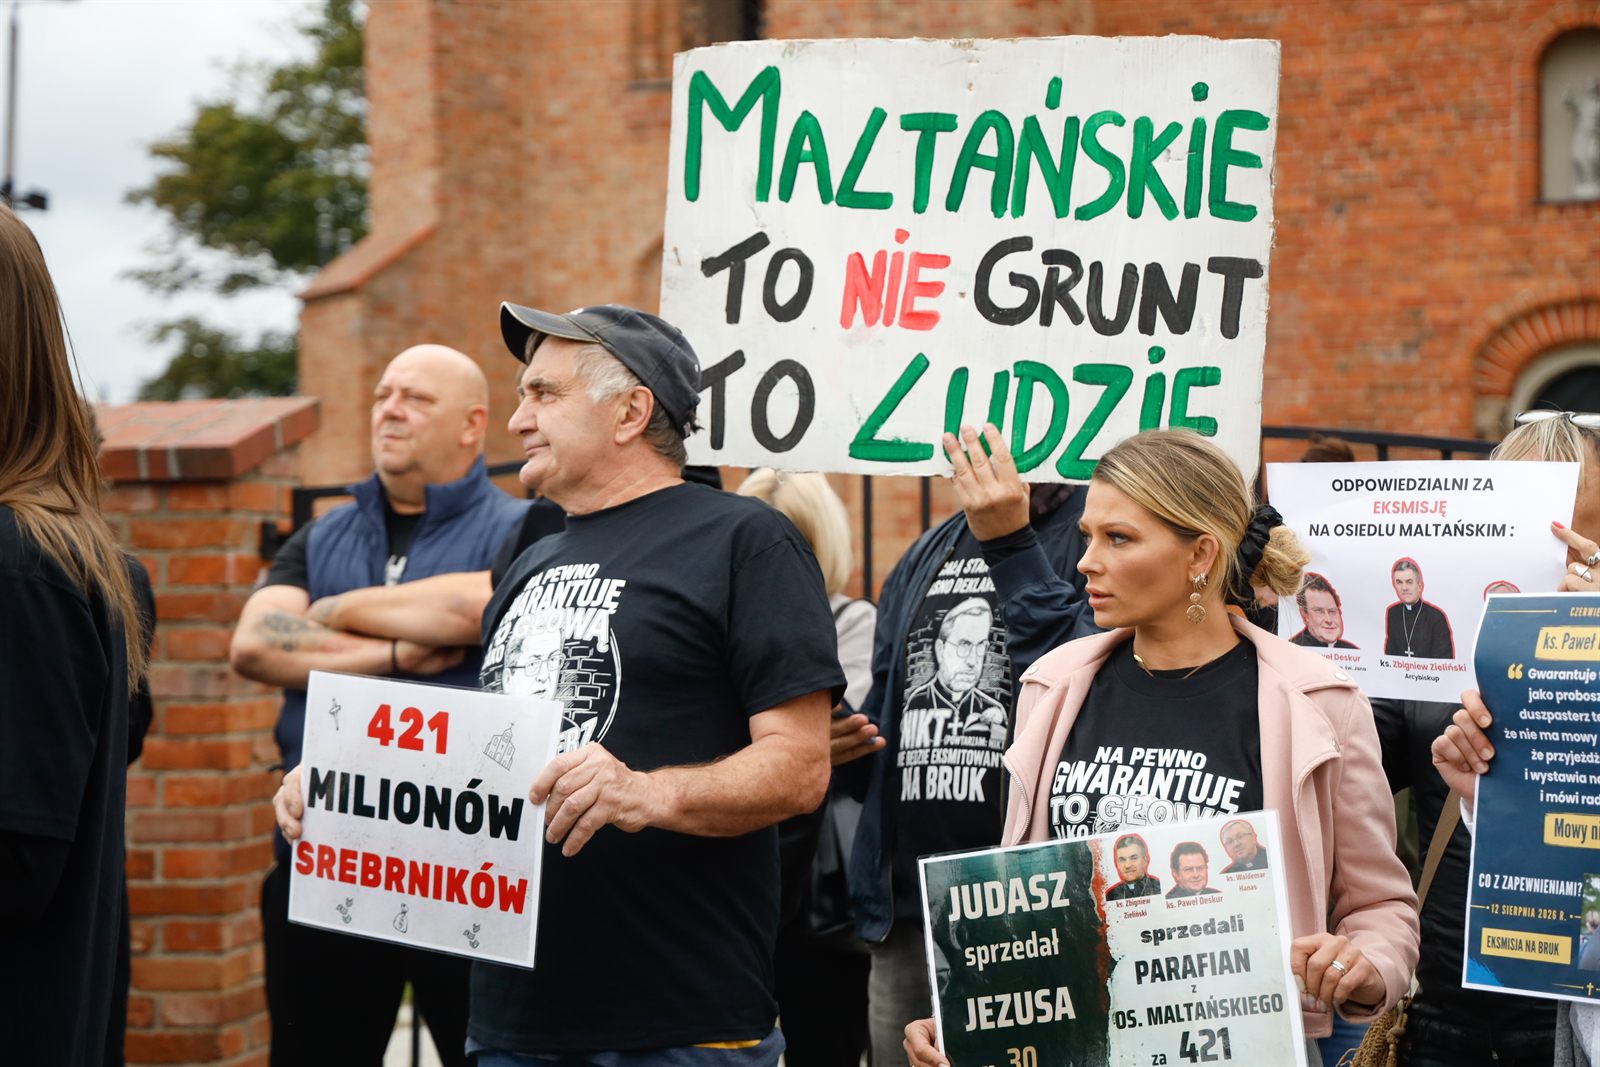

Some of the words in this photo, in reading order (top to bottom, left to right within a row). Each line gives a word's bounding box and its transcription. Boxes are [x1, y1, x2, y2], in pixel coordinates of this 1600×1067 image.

[701, 230, 814, 325] TO
[840, 228, 951, 331] NIE
[974, 236, 1264, 339] GRUNT
[700, 349, 815, 453] TO
[1331, 477, 1469, 493] ODPOWIEDZIALNI
[1472, 477, 1494, 492] ZA
[1373, 500, 1448, 517] EKSMISJĘ
[1309, 523, 1330, 537] NA
[1333, 523, 1396, 537] OSIEDLU
[1399, 519, 1507, 537] MALTAŃSKIM
[542, 563, 600, 585] PEWNO
[1543, 631, 1557, 649] ks.
[1561, 632, 1596, 650] Paweł
[1334, 653, 1360, 662] Deskur
[1380, 659, 1391, 667] ks.
[1393, 660, 1429, 671] Zbigniew
[1430, 663, 1467, 672] Zieliński
[1405, 673, 1440, 683] Arcybiskup
[1529, 688, 1554, 703] jako
[1519, 709, 1590, 723] duszpasterz
[367, 703, 449, 755] 421
[900, 708, 953, 750] NIKT
[1504, 728, 1517, 739] że
[1519, 728, 1537, 740] nie
[1539, 731, 1559, 741] ma
[1561, 732, 1597, 747] mowy
[1094, 746, 1124, 764] NA
[1129, 747, 1207, 770] PEWNO
[1531, 748, 1544, 760] że
[901, 766, 920, 802] NA
[925, 765, 987, 802] BRUK
[1052, 760, 1245, 814] GWARANTUJĘ
[1524, 768, 1528, 780] i
[1530, 771, 1587, 785] wystawia
[307, 767, 525, 841] MILIONÓW
[1540, 789, 1543, 802] i
[1546, 791, 1579, 804] mówi
[1050, 793, 1089, 825] TO
[1554, 818, 1588, 844] Mowy
[295, 840, 528, 915] SREBRNIKÓW
[1236, 872, 1266, 881] Waldemar
[1478, 873, 1491, 888] CO
[1494, 875, 1500, 889] Z
[1502, 875, 1583, 897] ZAPEWNIENIAMI?
[948, 871, 1070, 922] JUDASZ
[1125, 898, 1151, 907] Zbigniew
[1166, 901, 1177, 909] ks.
[1200, 896, 1224, 905] Deskur
[1124, 910, 1148, 919] Zieliński
[1491, 904, 1499, 914] 12
[1502, 905, 1535, 918] SIERPNIA
[1559, 911, 1567, 921] R.
[1140, 914, 1245, 946] sprzedali
[964, 928, 1059, 971] sprzedał
[1487, 935, 1523, 952] EKSMISJA
[1525, 939, 1536, 953] NA
[1538, 941, 1559, 956] BRUK
[1134, 948, 1251, 985] PARAFIAN
[965, 987, 1076, 1032] JEZUSA
[1115, 1009, 1143, 1030] OS.
[1146, 993, 1284, 1026] MALTAŃSKIEGO
[1151, 1052, 1167, 1066] za
[1179, 1027, 1232, 1063] 421
